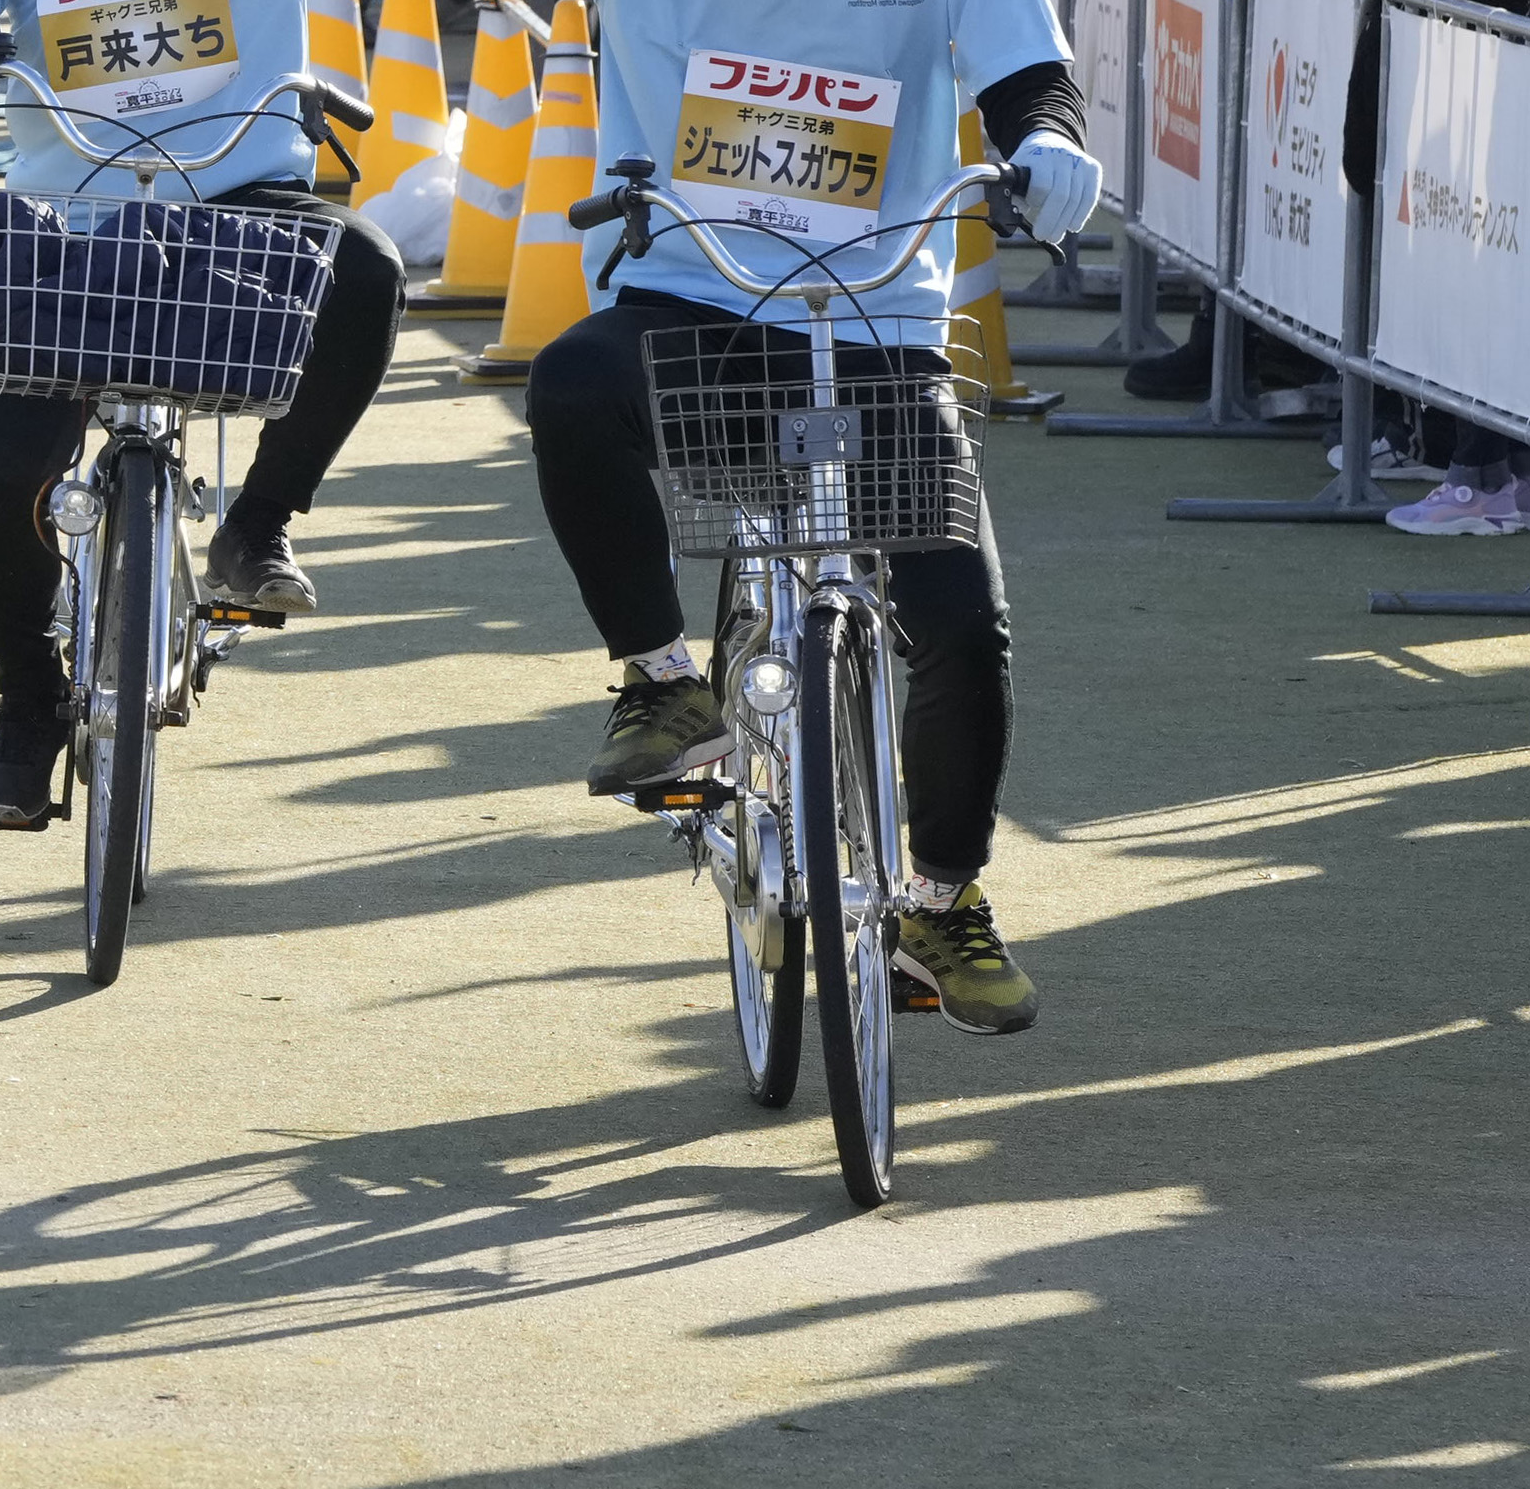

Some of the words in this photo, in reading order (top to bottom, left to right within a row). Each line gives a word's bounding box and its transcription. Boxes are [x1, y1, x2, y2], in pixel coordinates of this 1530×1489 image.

[56, 14, 225, 82] 戸来大ち
[708, 56, 879, 113] フジパン
[1292, 53, 1318, 109] トヨタ
[737, 106, 835, 136] ギャグ三兄弟
[682, 125, 878, 198] ジェットスガワラ
[1291, 124, 1327, 186] モビリティ
